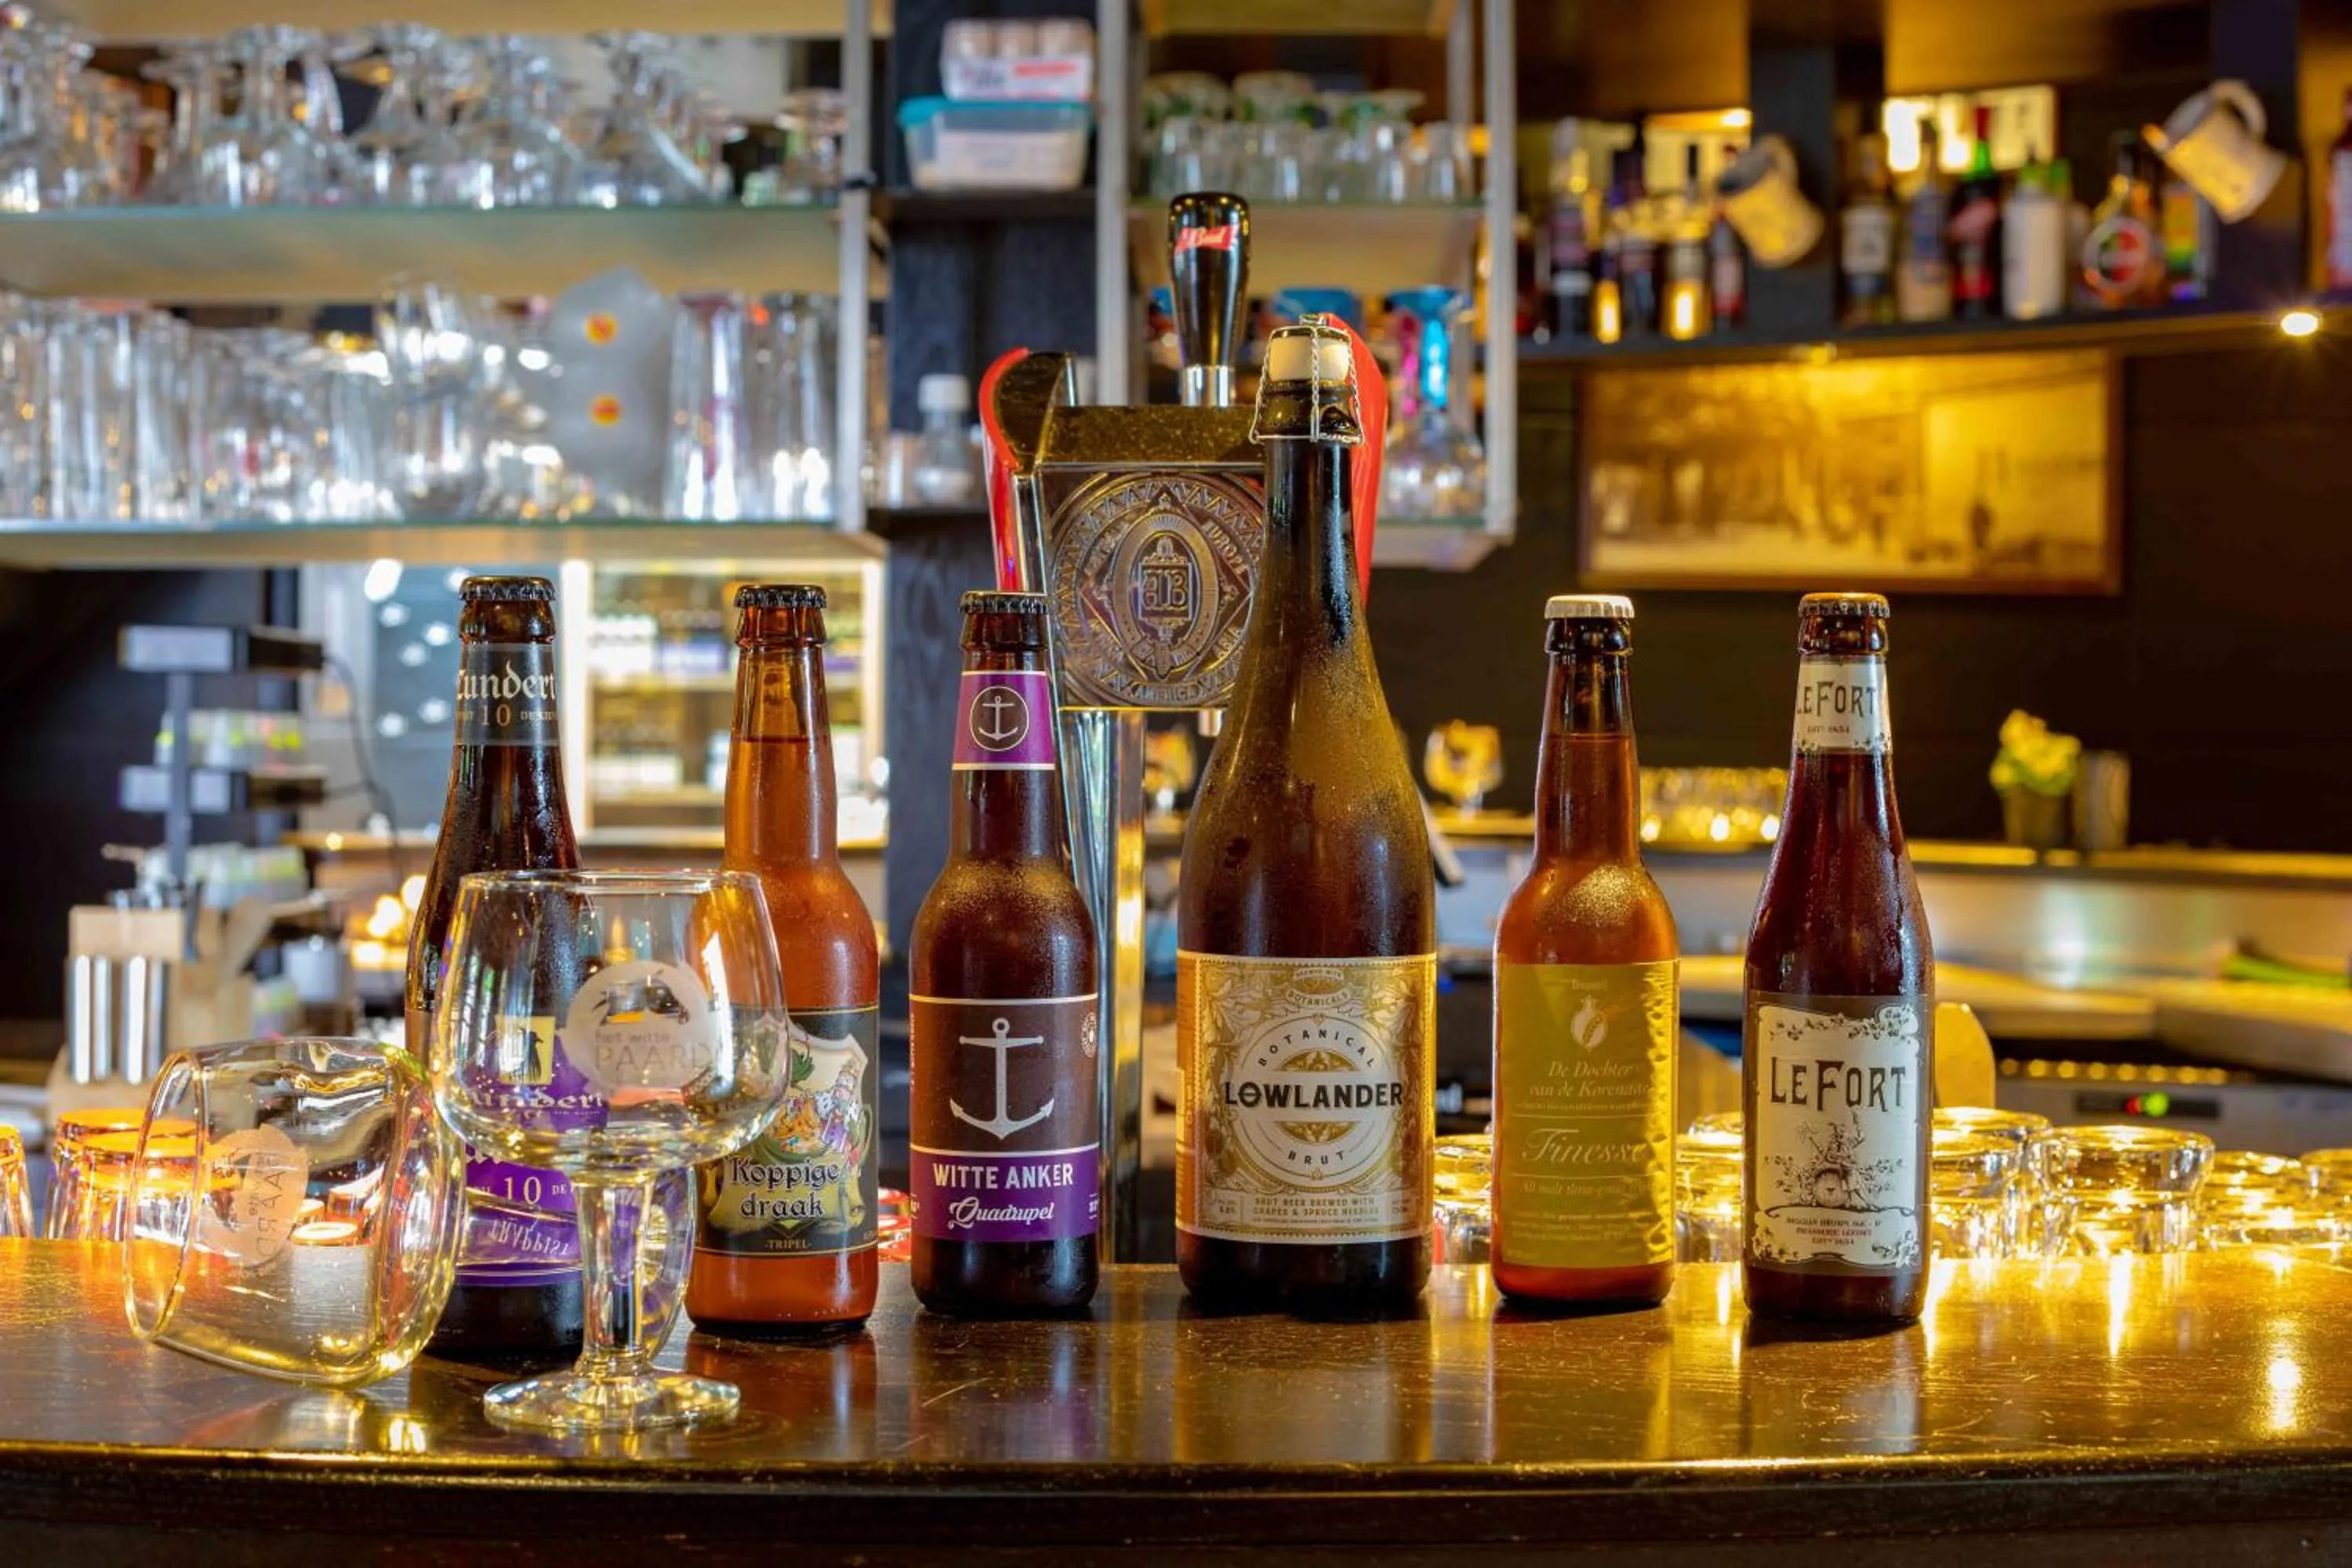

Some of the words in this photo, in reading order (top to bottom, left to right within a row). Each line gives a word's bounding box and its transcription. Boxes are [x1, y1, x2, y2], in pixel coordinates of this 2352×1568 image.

[1258, 1029, 1375, 1067] BOTANICAL
[1224, 1081, 1403, 1109] LOWLANDER
[1288, 1150, 1346, 1165] BRUT
[1522, 1127, 1647, 1165] Finesse
[728, 1156, 841, 1192] Koppige
[933, 1163, 999, 1190] WITTE
[1004, 1163, 1074, 1189] ANKER
[504, 1176, 542, 1205] 10
[740, 1191, 826, 1218] draak
[946, 1197, 1054, 1230] Quadrupel
